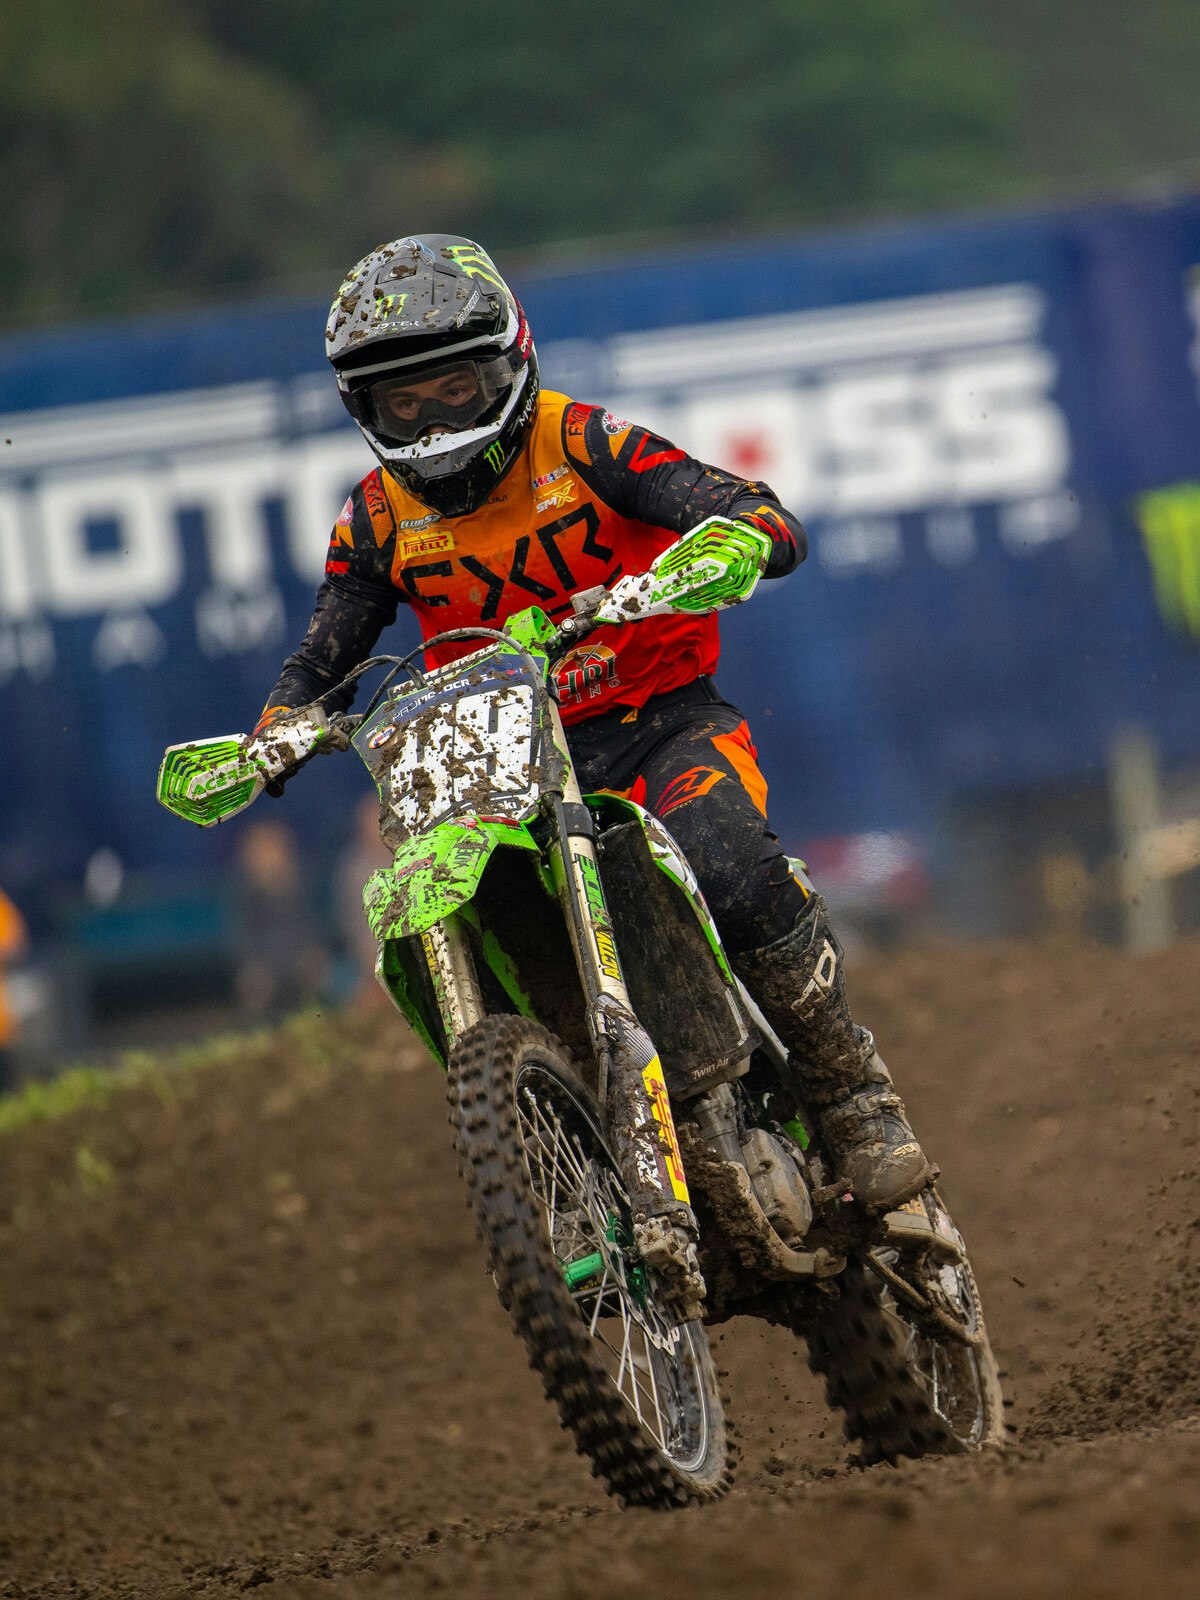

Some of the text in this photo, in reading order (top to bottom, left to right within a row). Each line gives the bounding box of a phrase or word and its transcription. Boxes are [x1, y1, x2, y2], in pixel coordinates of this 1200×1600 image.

[568, 408, 591, 438] FXR
[367, 479, 387, 517] FXR
[400, 502, 613, 622] FXR
[404, 535, 449, 556] PIRELLI
[579, 854, 623, 983] ACTIV RIDE
[691, 1056, 729, 1080] Twin Air
